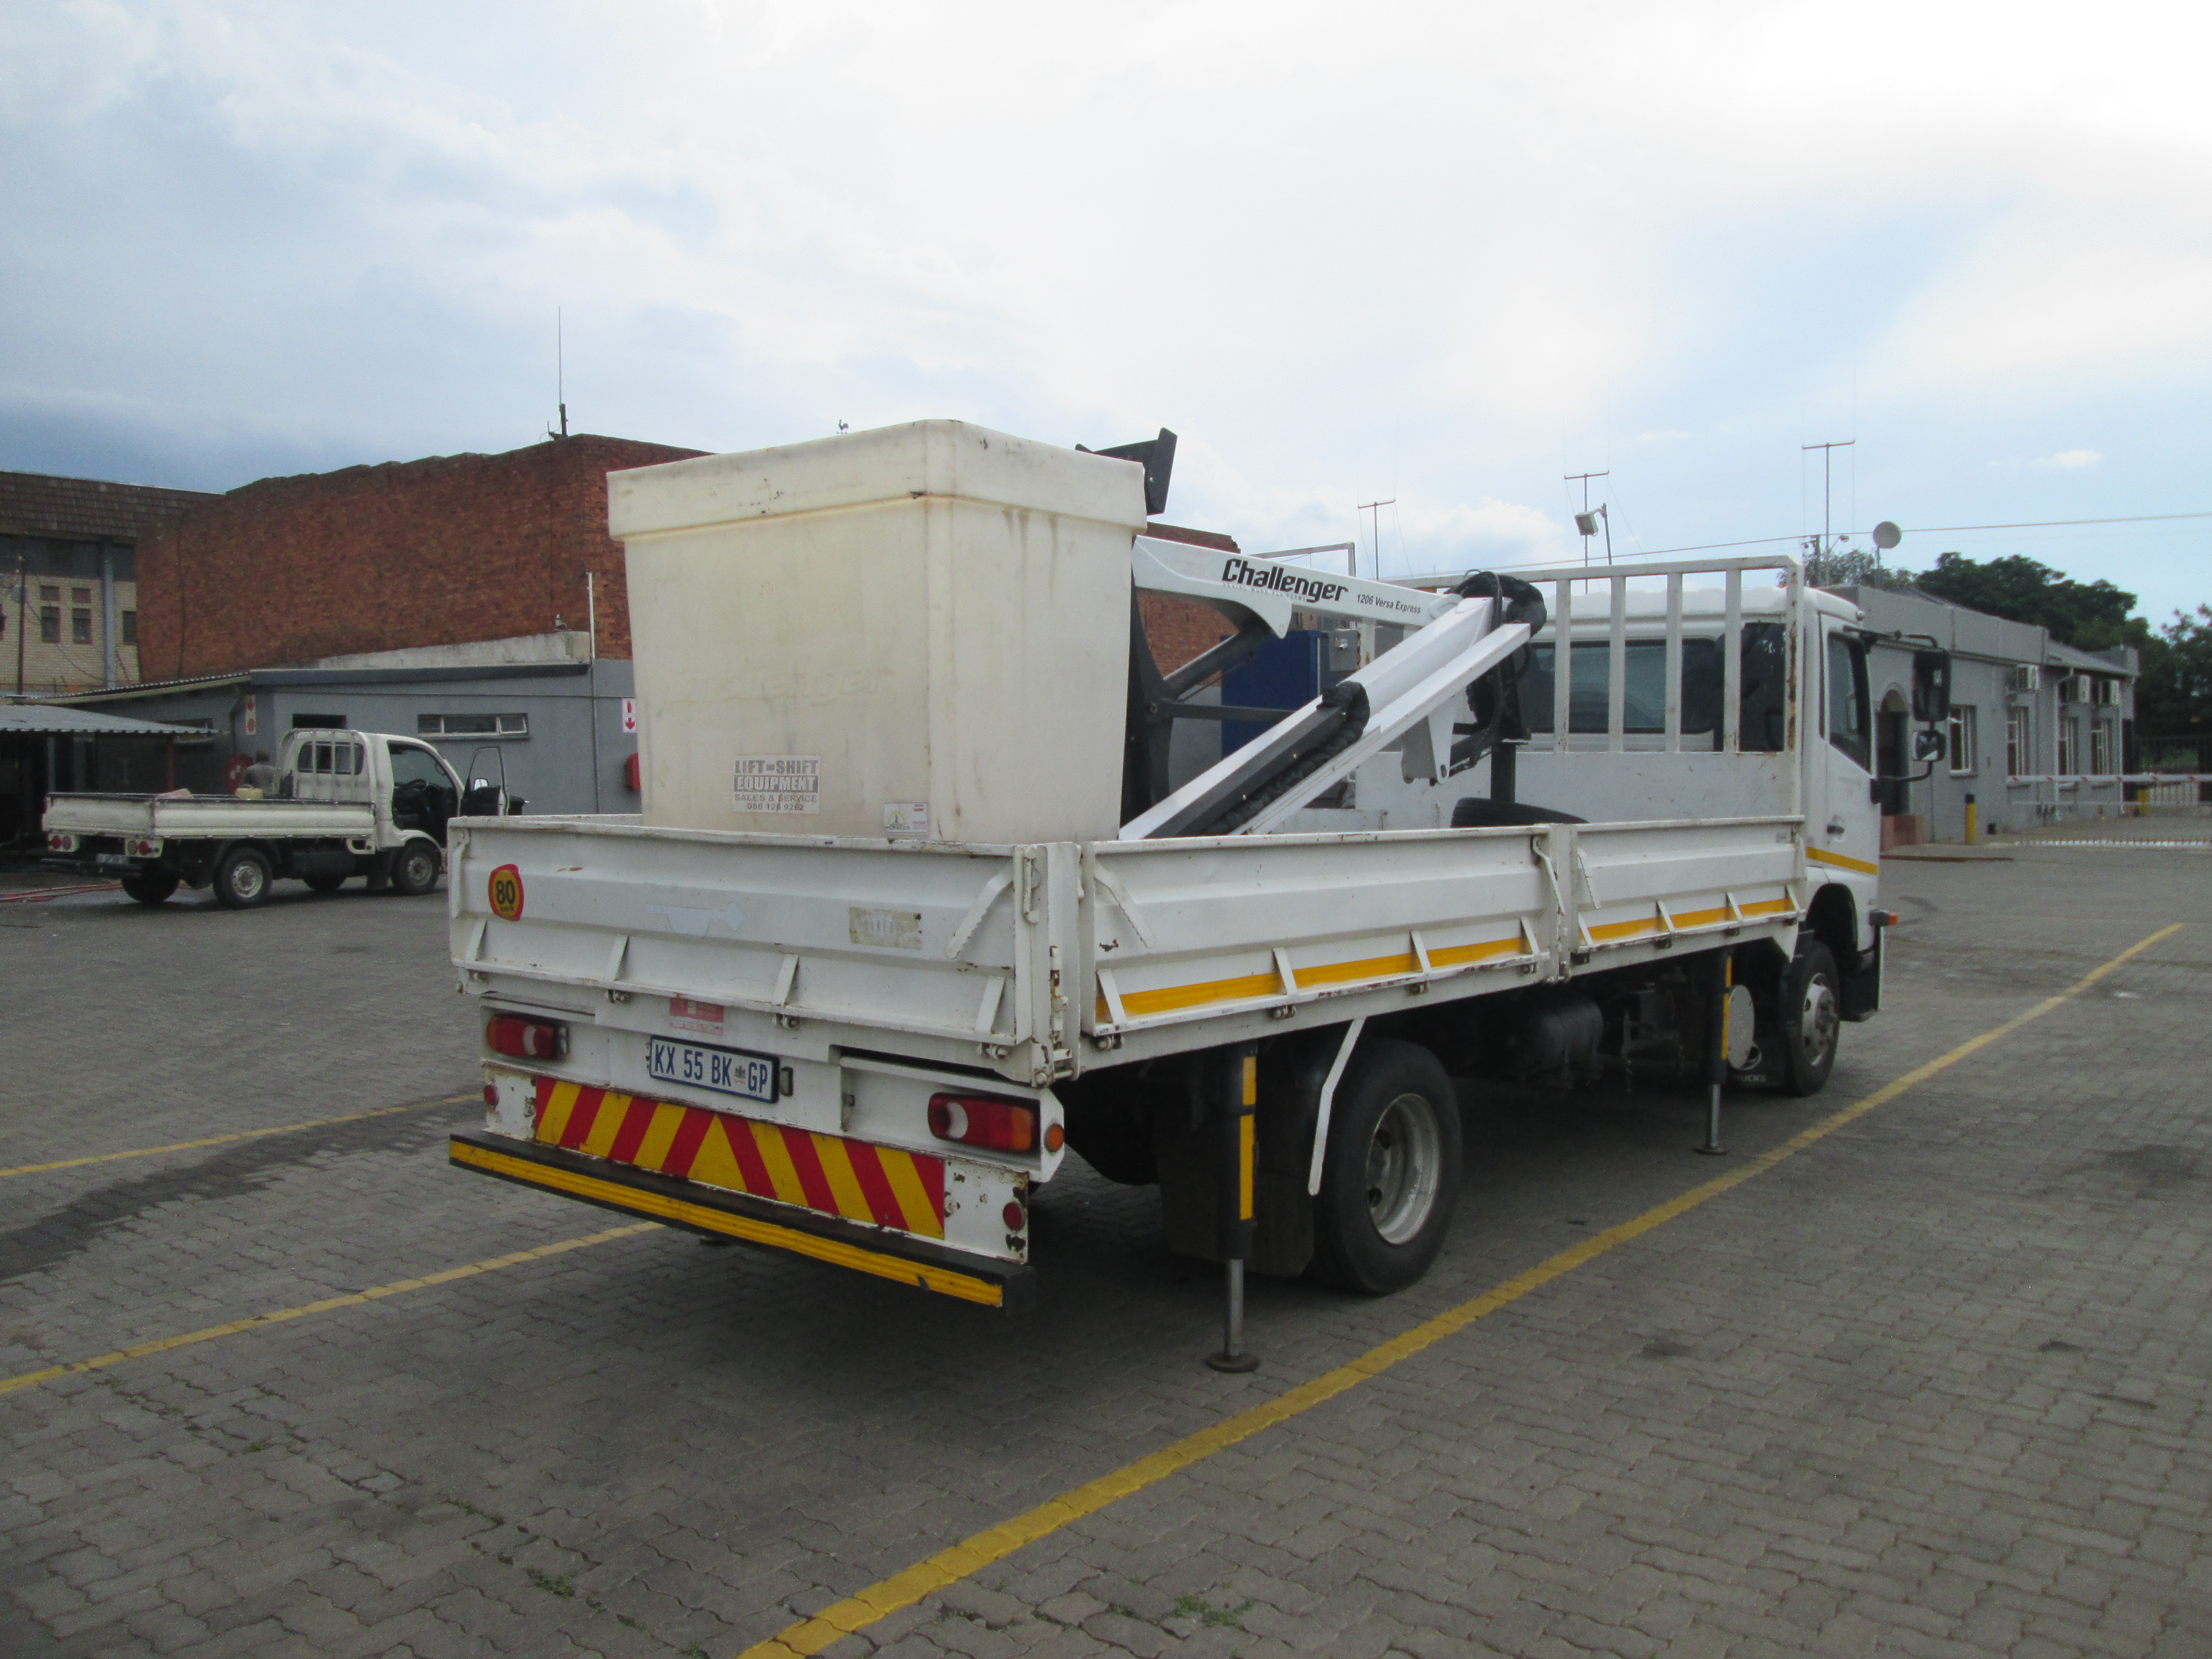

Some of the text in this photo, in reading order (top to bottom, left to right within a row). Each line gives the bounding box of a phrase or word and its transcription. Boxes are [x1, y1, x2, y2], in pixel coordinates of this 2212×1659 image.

[1222, 558, 1349, 602] Challenger
[1357, 593, 1421, 613] 1206 Versa Express
[735, 760, 765, 773] LIFT
[776, 760, 818, 774] SHIFT
[737, 776, 816, 790] EQUIPMENT
[778, 794, 817, 802] SERVICE
[496, 880, 516, 904] 80
[655, 1044, 768, 1094] KX 55 BK GP
